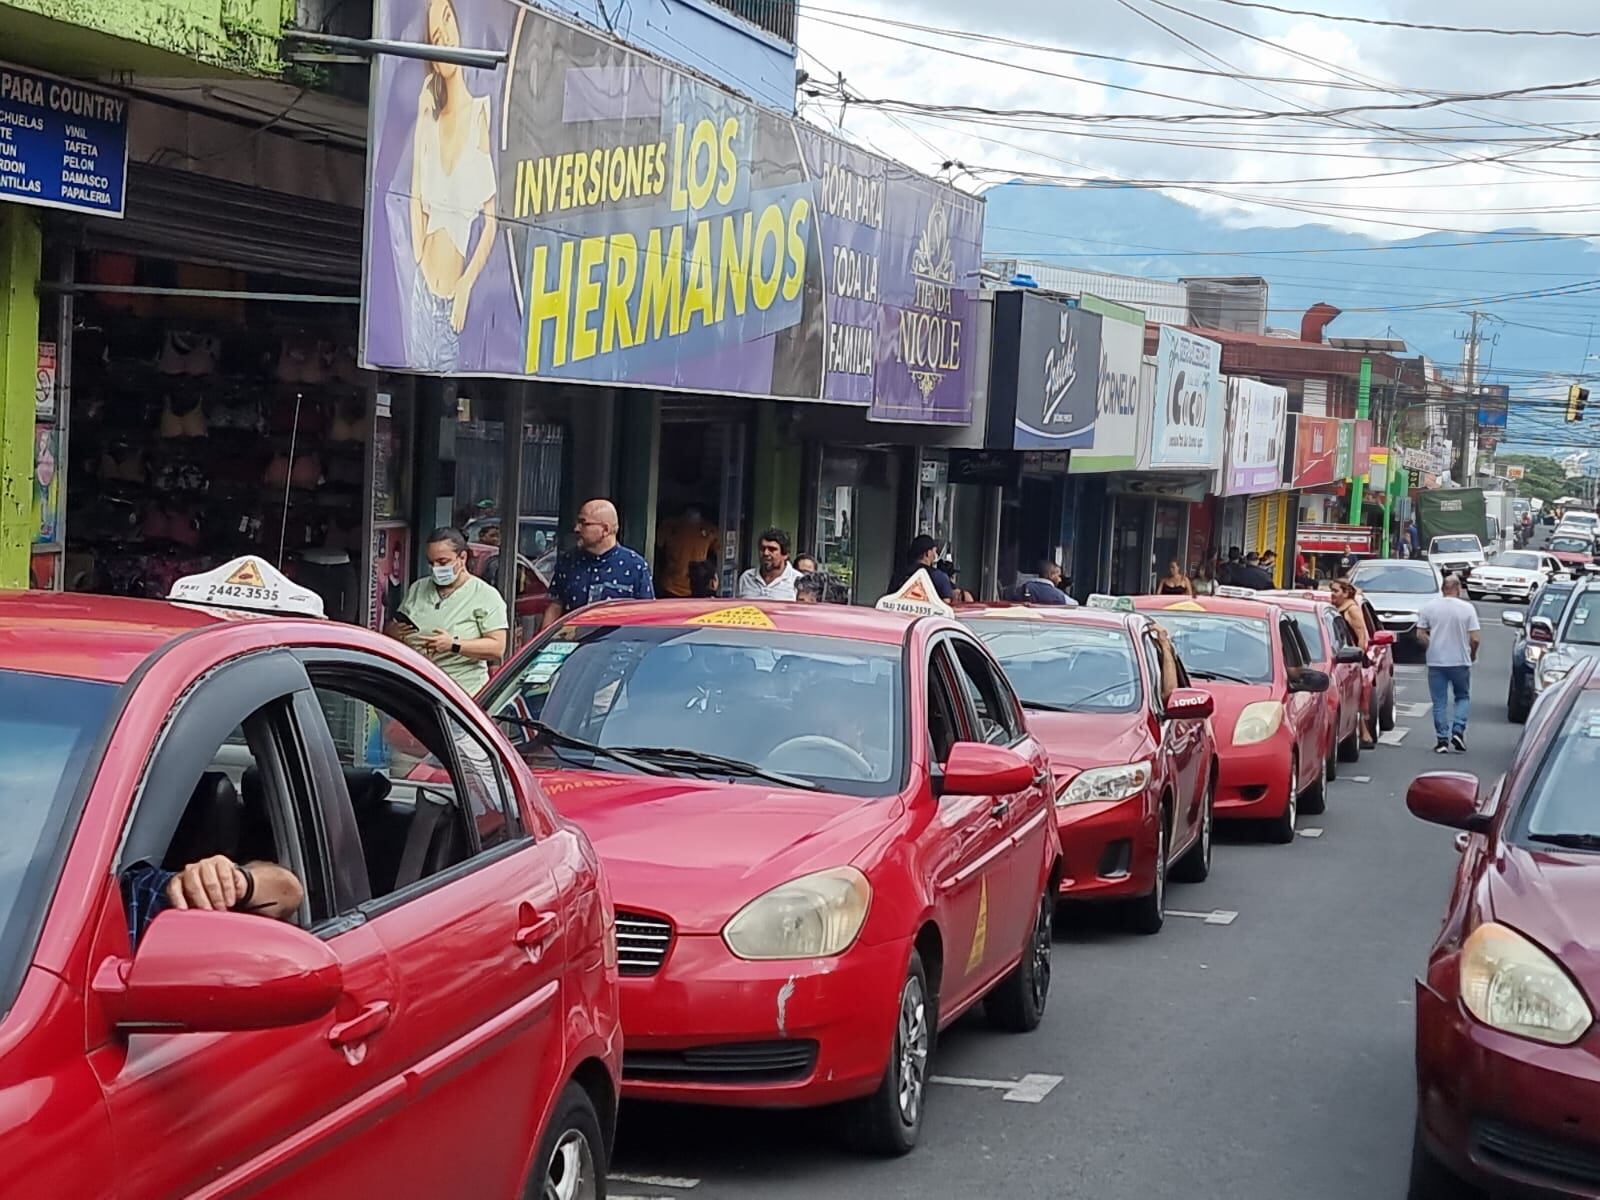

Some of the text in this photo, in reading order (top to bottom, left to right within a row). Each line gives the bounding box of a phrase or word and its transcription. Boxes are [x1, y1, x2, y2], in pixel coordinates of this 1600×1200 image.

[1, 73, 124, 123] PARA COUNTRY
[64, 140, 98, 157] TAFETA
[65, 124, 88, 139] VINIL
[0, 175, 41, 193] NTILLAS
[62, 170, 109, 189] DAMASCO
[63, 155, 95, 171] PELON
[514, 142, 667, 218] INVERSIONES
[671, 117, 738, 212] LOS
[61, 185, 111, 205] PAPALERIA
[820, 162, 884, 230] ROPA PARA
[525, 199, 808, 374] HERMANOS
[832, 246, 878, 304] TODA LA
[914, 279, 952, 314] TIENDA
[828, 323, 872, 375] FAMILIA
[897, 310, 961, 370] NICOLE
[208, 584, 279, 601] 2442-3535
